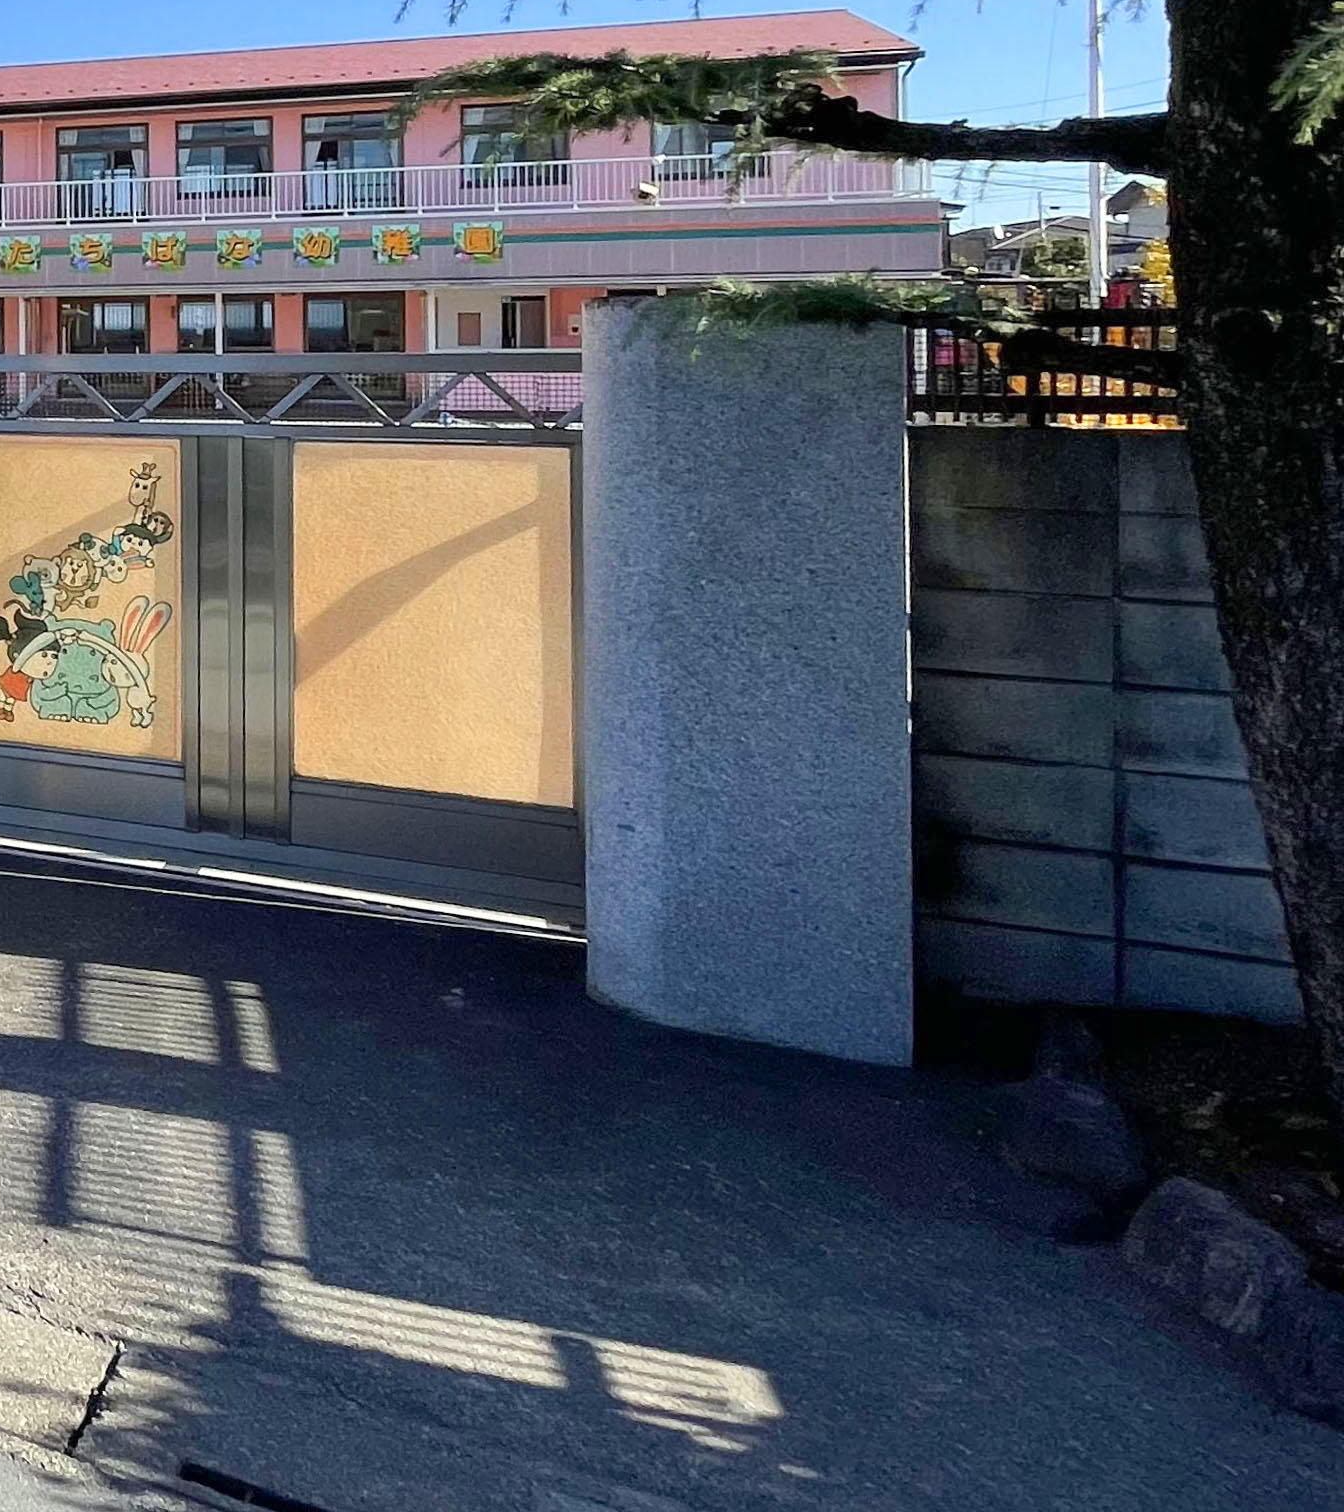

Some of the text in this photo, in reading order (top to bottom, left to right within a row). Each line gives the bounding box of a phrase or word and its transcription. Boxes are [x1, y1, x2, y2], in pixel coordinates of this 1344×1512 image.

[3, 227, 495, 266] たちばな幼稚園
